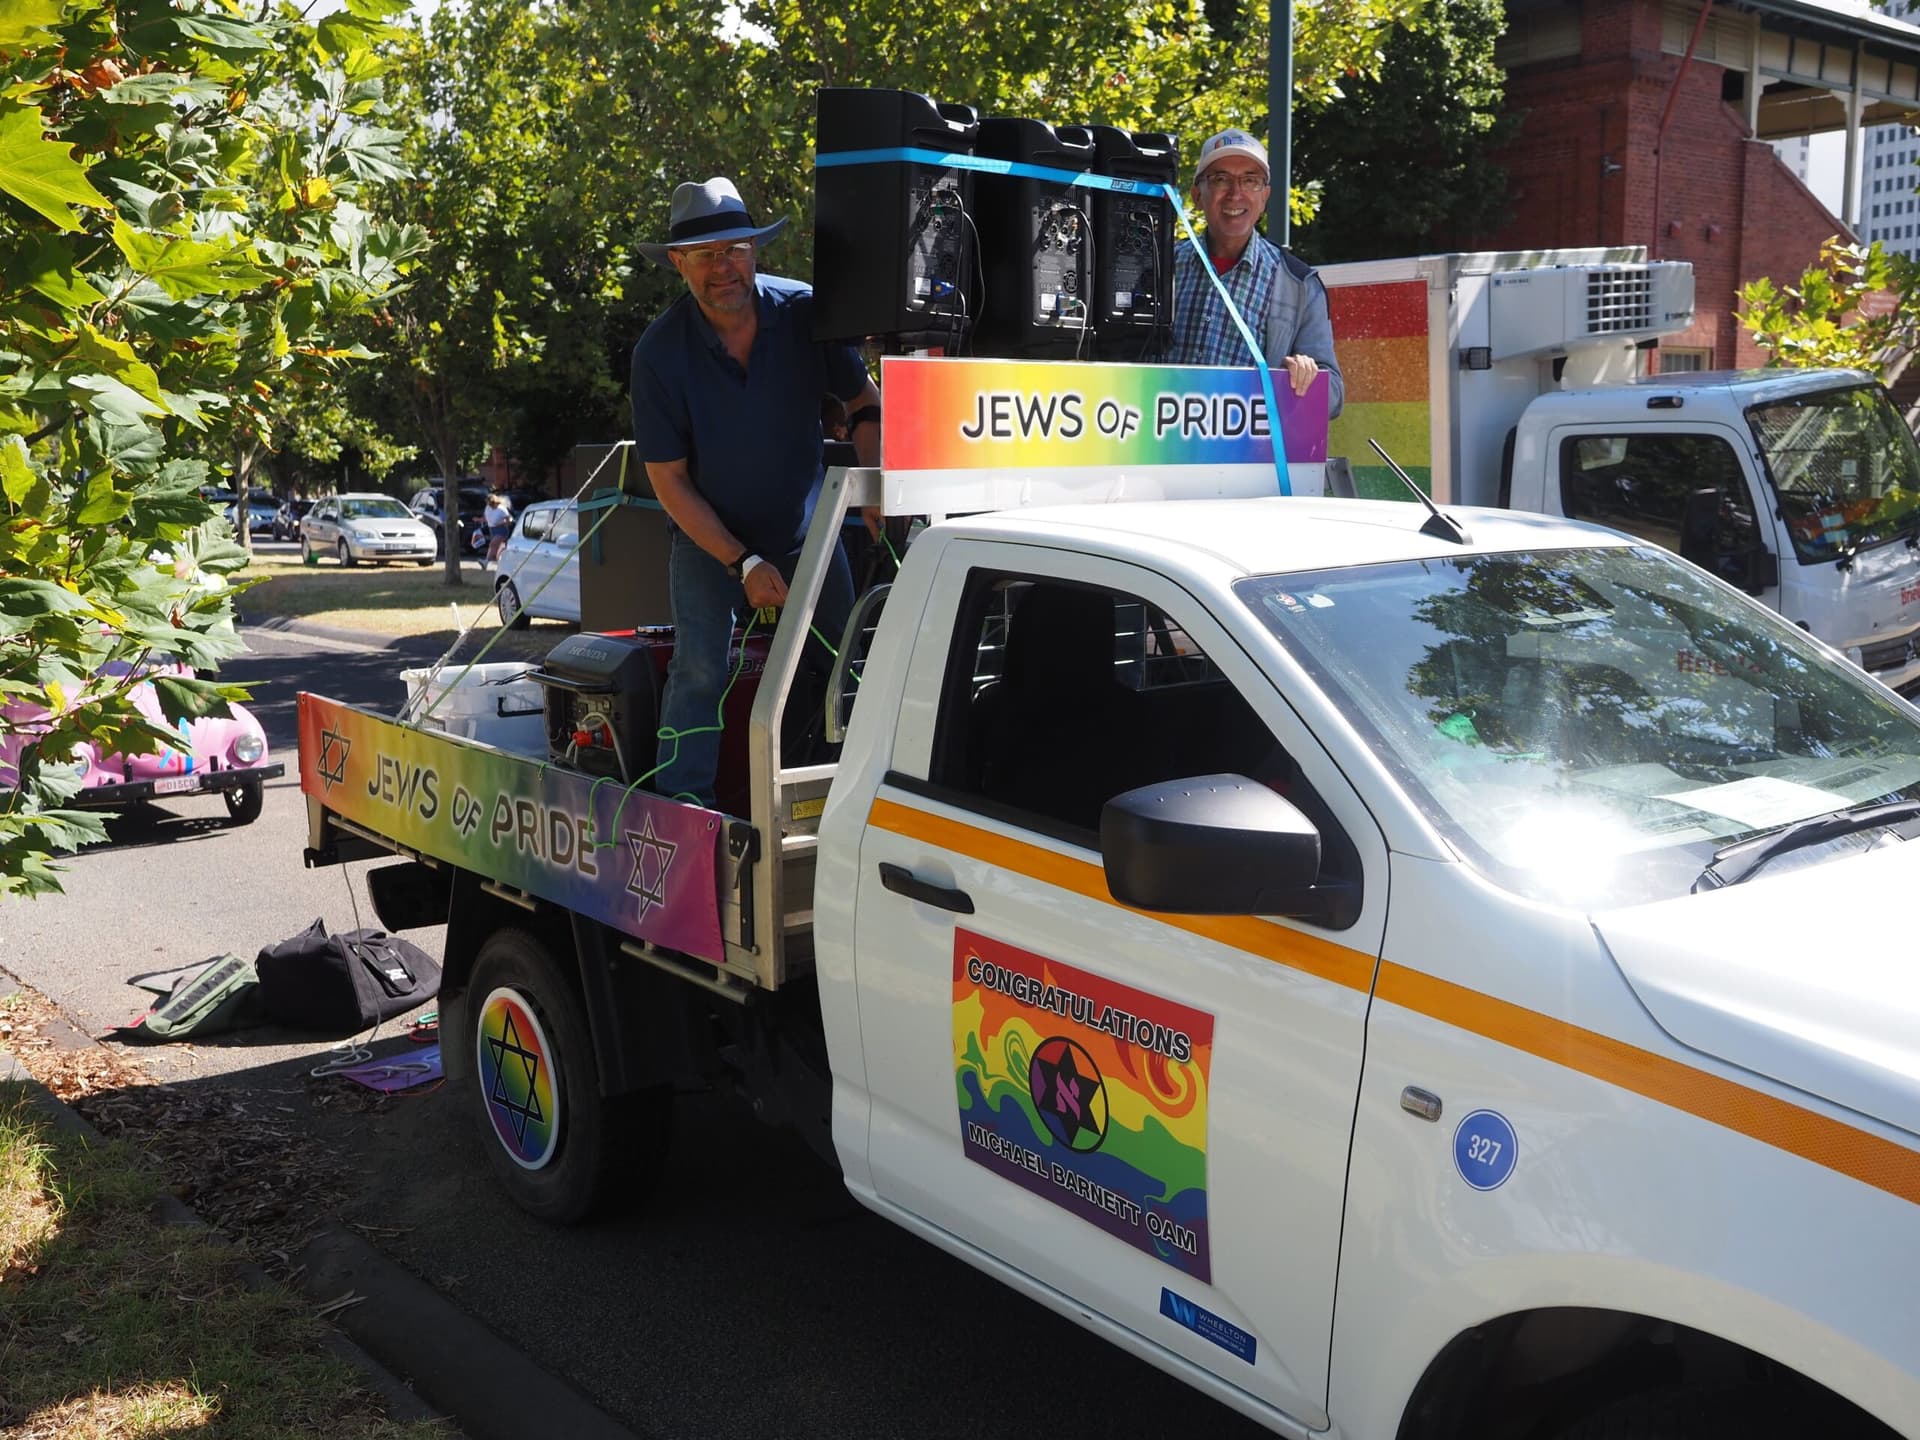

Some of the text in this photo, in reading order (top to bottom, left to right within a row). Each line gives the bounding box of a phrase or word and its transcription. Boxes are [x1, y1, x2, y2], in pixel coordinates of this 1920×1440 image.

[961, 394, 1273, 439] JEWS OF PRIDE
[568, 646, 608, 661] HONDA
[367, 753, 598, 877] JEWS OF PRIDE
[967, 956, 1191, 1063] CONGRATULATIONS
[1468, 1134, 1502, 1166] 327
[967, 1121, 1197, 1255] MICHAEL BARNETT OAM
[1199, 1312, 1247, 1344] WHEELTON
